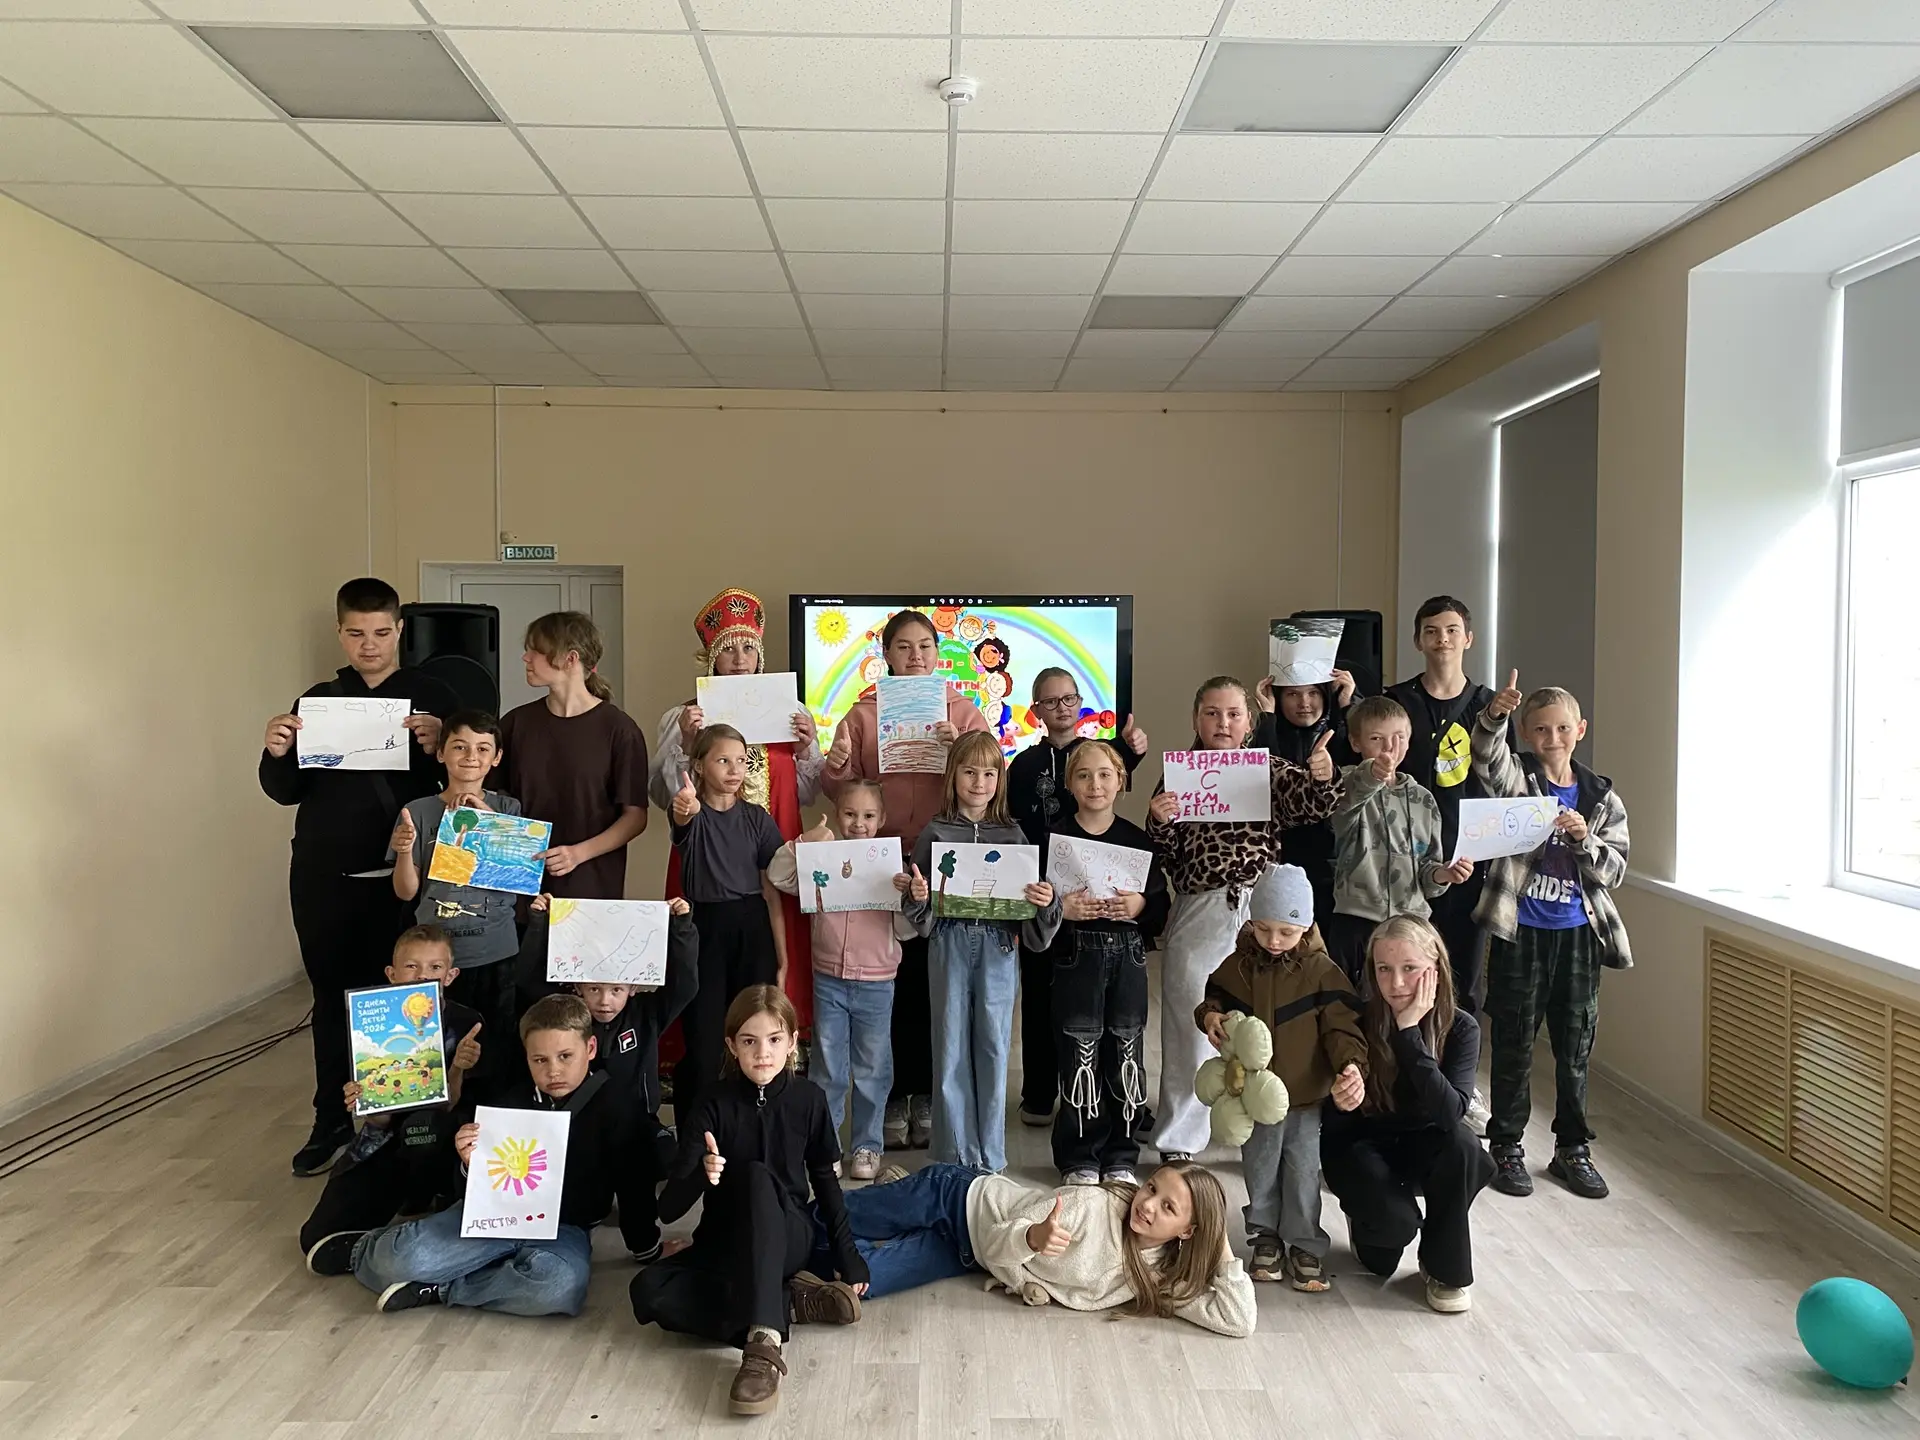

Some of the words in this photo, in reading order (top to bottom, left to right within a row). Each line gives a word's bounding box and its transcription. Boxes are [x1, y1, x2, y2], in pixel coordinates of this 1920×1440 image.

[506, 547, 553, 559] ВЫХОД
[1200, 769, 1221, 790] С
[1174, 791, 1219, 806] НЕМ
[1526, 873, 1574, 904] RIDE
[357, 1000, 363, 1009] С
[357, 1006, 390, 1018] ЗАЩИТЫ
[361, 1014, 387, 1026] ДЕТЕЙ
[364, 1023, 386, 1034] 2026
